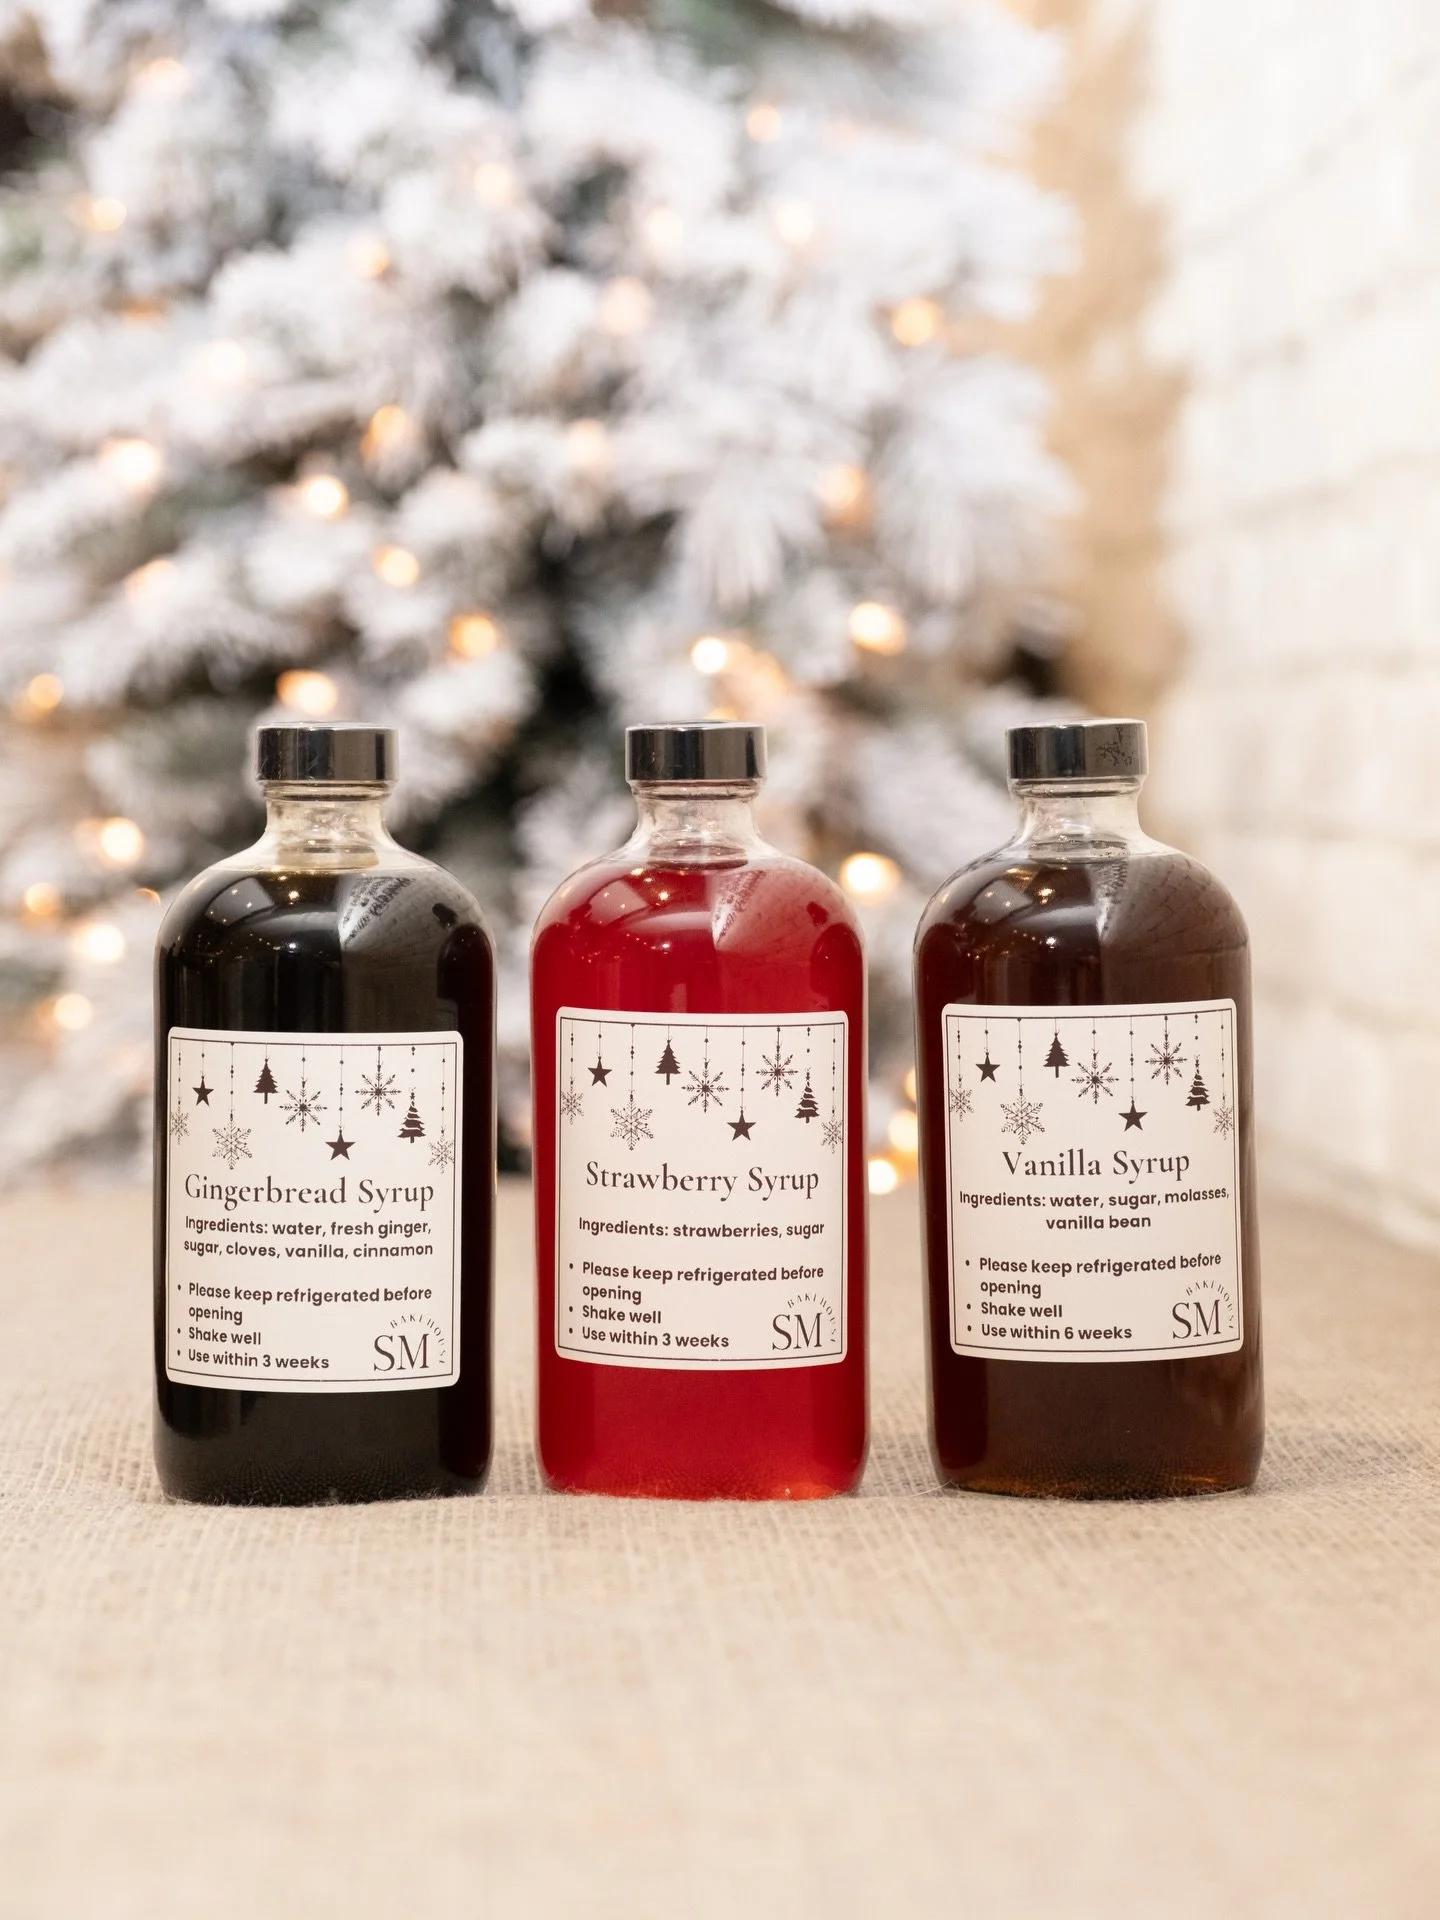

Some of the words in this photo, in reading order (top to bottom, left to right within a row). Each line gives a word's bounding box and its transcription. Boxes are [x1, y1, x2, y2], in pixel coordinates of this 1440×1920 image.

[1002, 1148, 1102, 1176] Vanilla
[1113, 1149, 1190, 1185] Syrup
[586, 1160, 738, 1202] Strawberry
[748, 1166, 819, 1201] Syrup
[184, 1173, 347, 1212] Gingerbread
[358, 1178, 434, 1214] Syrup
[959, 1190, 1046, 1209] Ingredients:
[1049, 1194, 1104, 1209] water,
[1108, 1194, 1161, 1210] sugar,
[1164, 1187, 1230, 1204] molasses,
[185, 1215, 268, 1234] Ingredients:
[272, 1221, 327, 1238] water,
[330, 1221, 374, 1236] fresh
[377, 1220, 432, 1239] ginger,
[579, 1216, 669, 1236] Ingredients:
[672, 1222, 782, 1239] strawberries,
[786, 1223, 825, 1240] sugar
[1046, 1215, 1104, 1230] vanilla
[1109, 1215, 1152, 1229] bean
[184, 1240, 223, 1257] sugar,
[225, 1241, 281, 1259] cloves,
[285, 1243, 349, 1260] vanilla,
[352, 1243, 433, 1258] cinnamon
[582, 1261, 629, 1278] Please
[632, 1265, 673, 1285] keep
[677, 1267, 777, 1286] refrigerated
[781, 1265, 824, 1281] before
[980, 1257, 1028, 1273] Please
[1031, 1259, 1072, 1278] keep
[1076, 1255, 1176, 1277] refrigerated
[1180, 1253, 1222, 1269] before
[189, 1282, 231, 1299] Please
[234, 1286, 273, 1305] keep
[276, 1288, 380, 1307] refrigerated
[383, 1286, 432, 1302] before
[582, 1285, 642, 1306] opening
[980, 1280, 1042, 1300] opening
[188, 1306, 243, 1326] opening
[582, 1304, 625, 1322] Shake
[629, 1310, 662, 1324] well
[981, 1302, 1026, 1317] Shake
[1029, 1304, 1063, 1318] well
[1172, 1298, 1222, 1340] SM
[188, 1326, 228, 1343] Shake
[230, 1331, 261, 1345] well
[582, 1325, 606, 1342] Use
[609, 1329, 658, 1346] within
[662, 1332, 671, 1347] 3
[675, 1333, 730, 1348] weeks
[772, 1312, 823, 1351] SM
[981, 1323, 1007, 1338] Use
[1010, 1324, 1060, 1340] within
[1064, 1326, 1074, 1340] 6
[1077, 1326, 1133, 1340] weeks
[188, 1348, 210, 1363] Use
[212, 1351, 258, 1367] within
[262, 1354, 271, 1368] 3
[275, 1355, 330, 1369] weeks
[373, 1333, 429, 1372] SM
